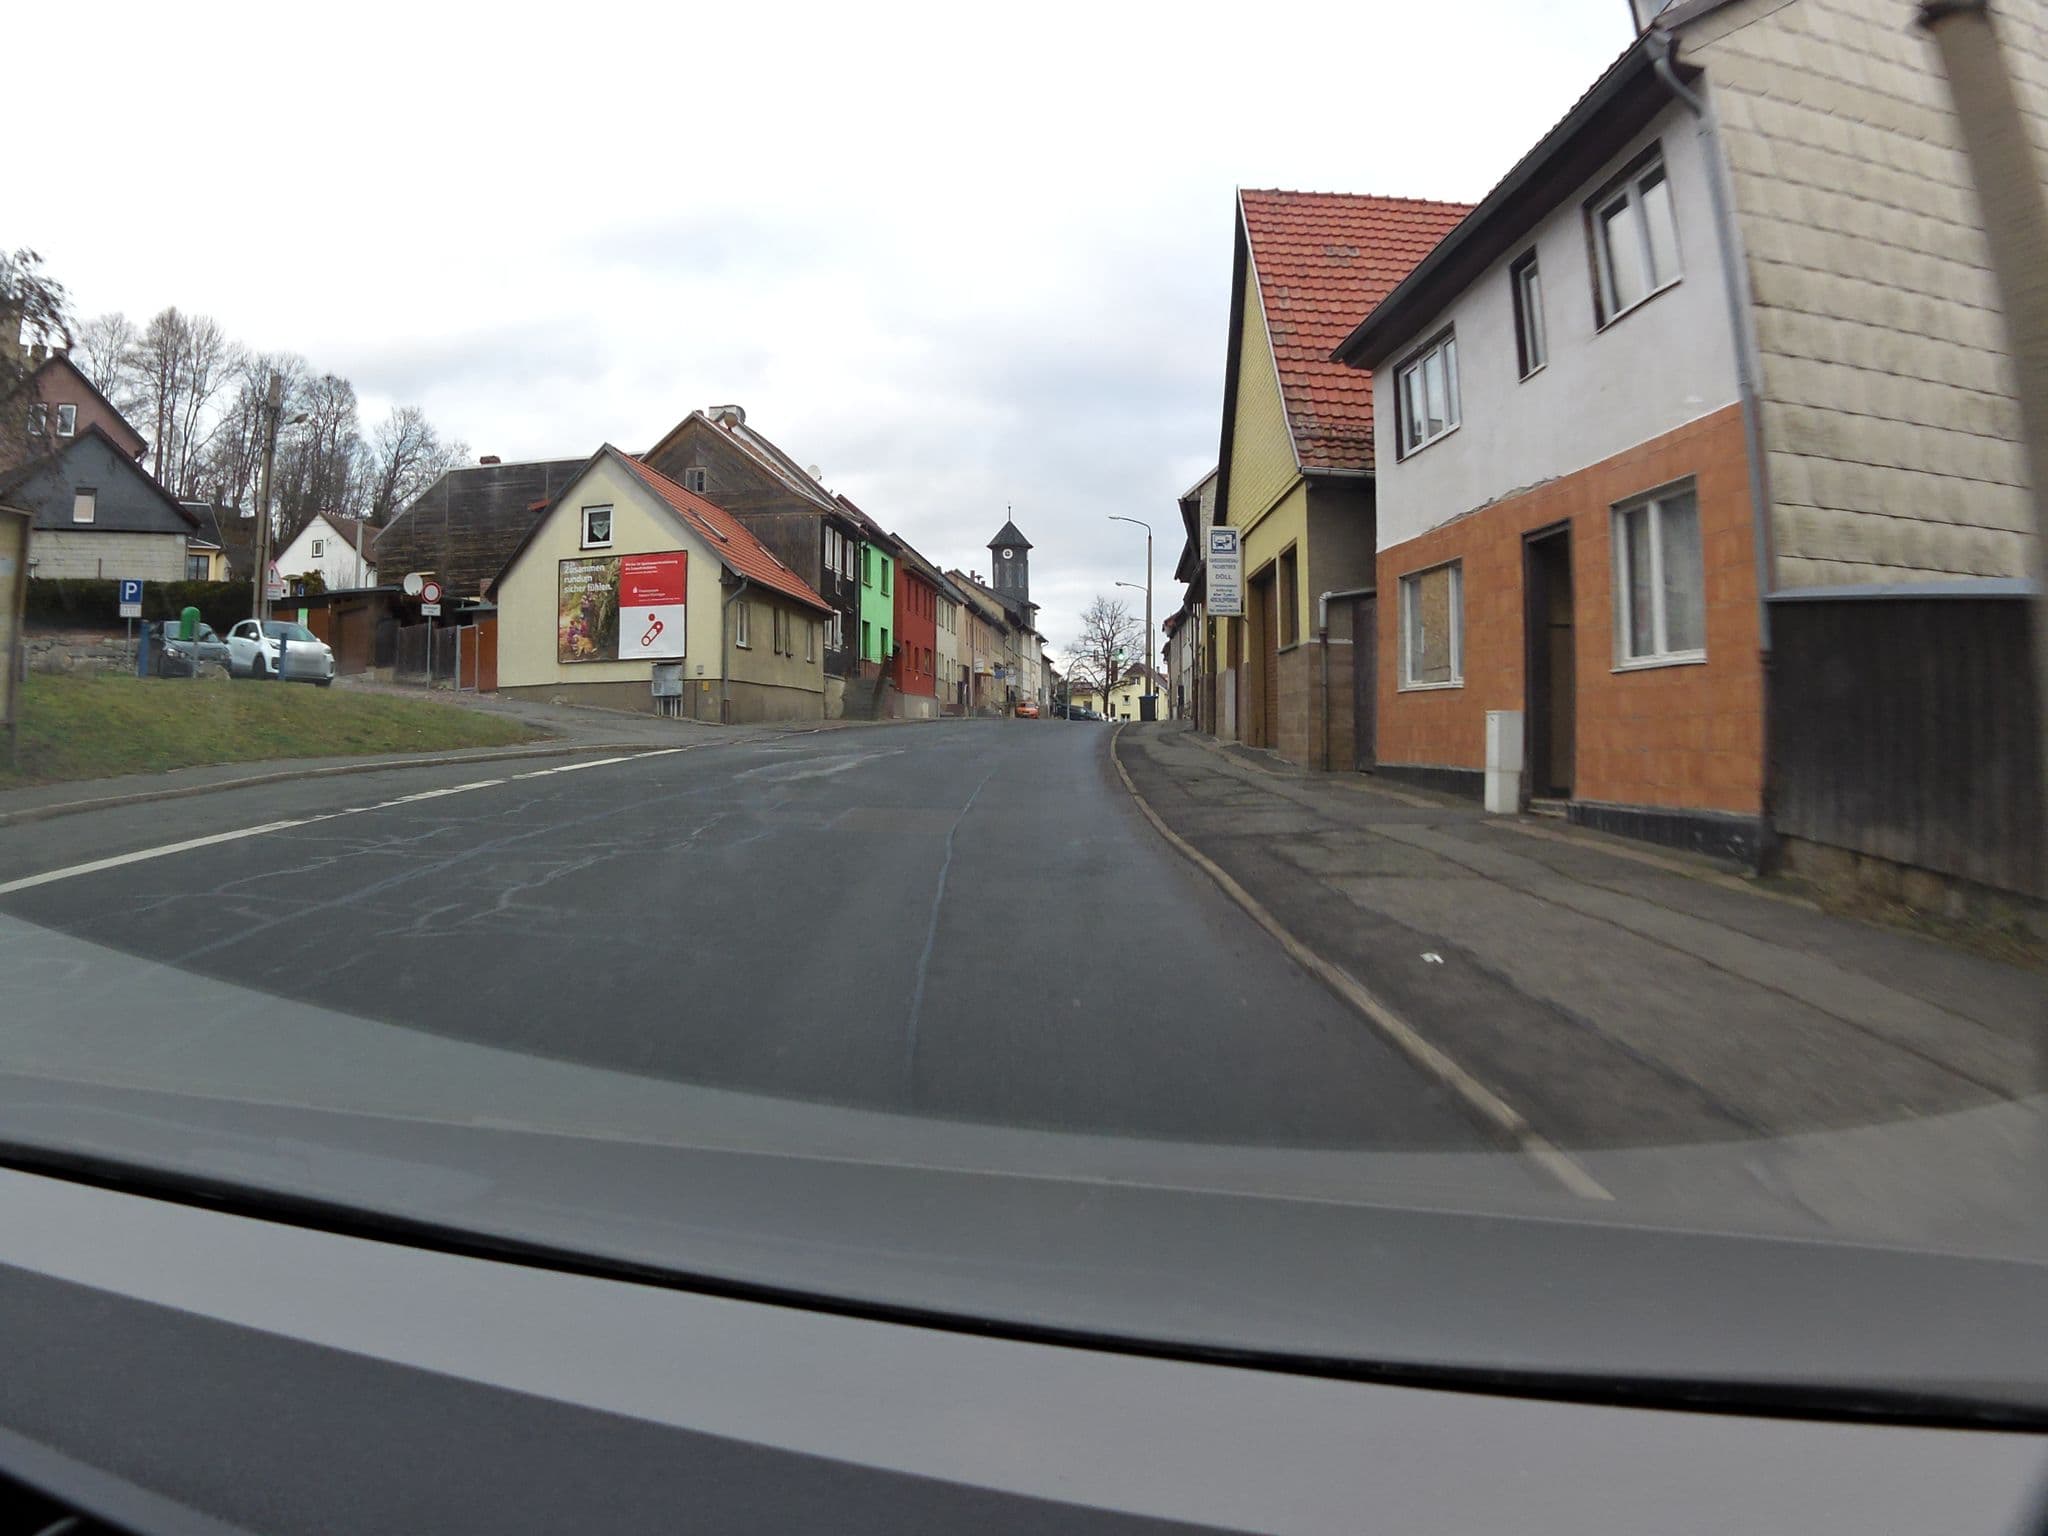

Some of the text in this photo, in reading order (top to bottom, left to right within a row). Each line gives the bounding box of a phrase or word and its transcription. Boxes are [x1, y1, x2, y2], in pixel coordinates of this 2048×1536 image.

[563, 564, 605, 574] Zusammen
[563, 575, 592, 583] rundum
[125, 582, 137, 600] P
[563, 584, 585, 594] sicher
